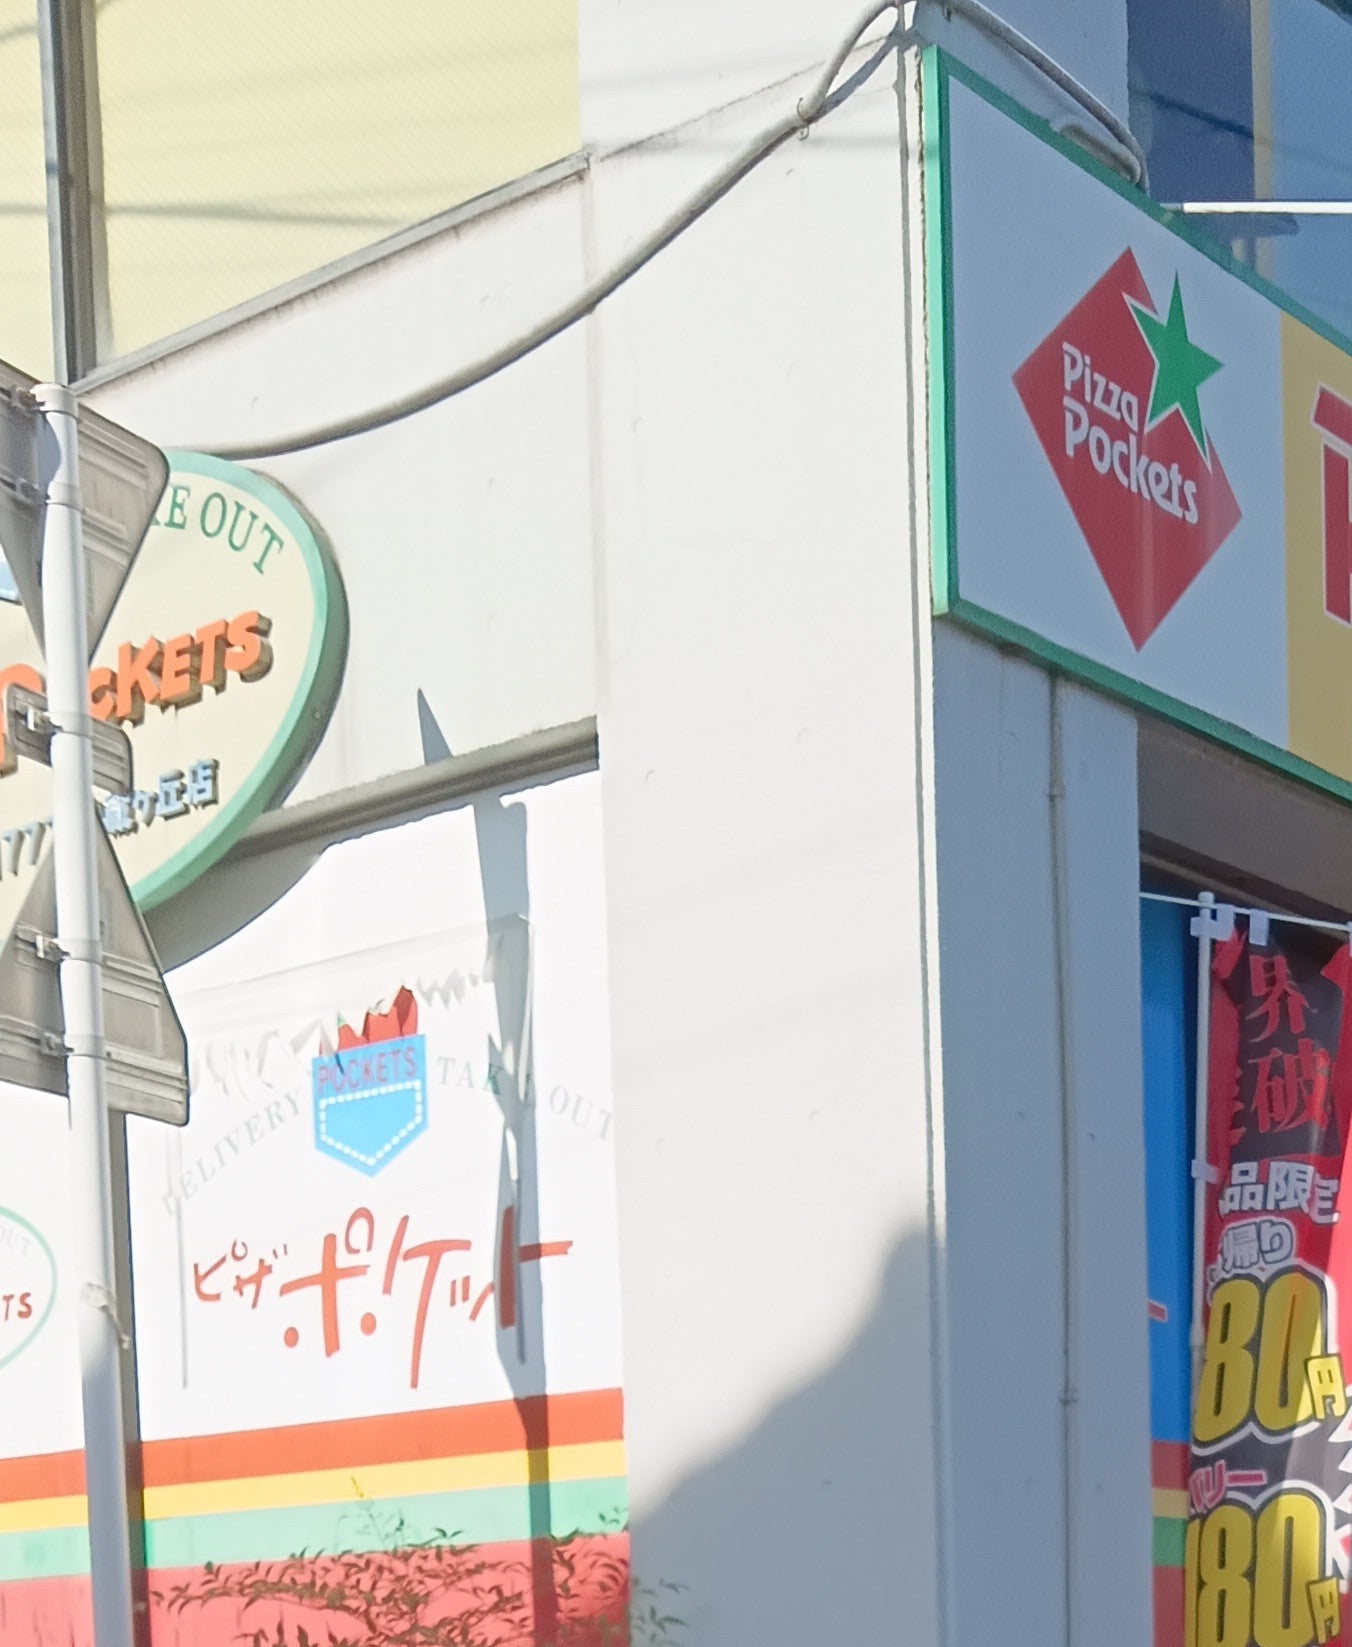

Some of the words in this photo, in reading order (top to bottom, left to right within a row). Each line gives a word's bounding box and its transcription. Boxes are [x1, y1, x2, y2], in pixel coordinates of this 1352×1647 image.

[1061, 340, 1139, 433] Pizza
[1062, 394, 1199, 526] Pockets
[199, 491, 284, 574] OUT
[317, 1045, 419, 1094] POCKETS
